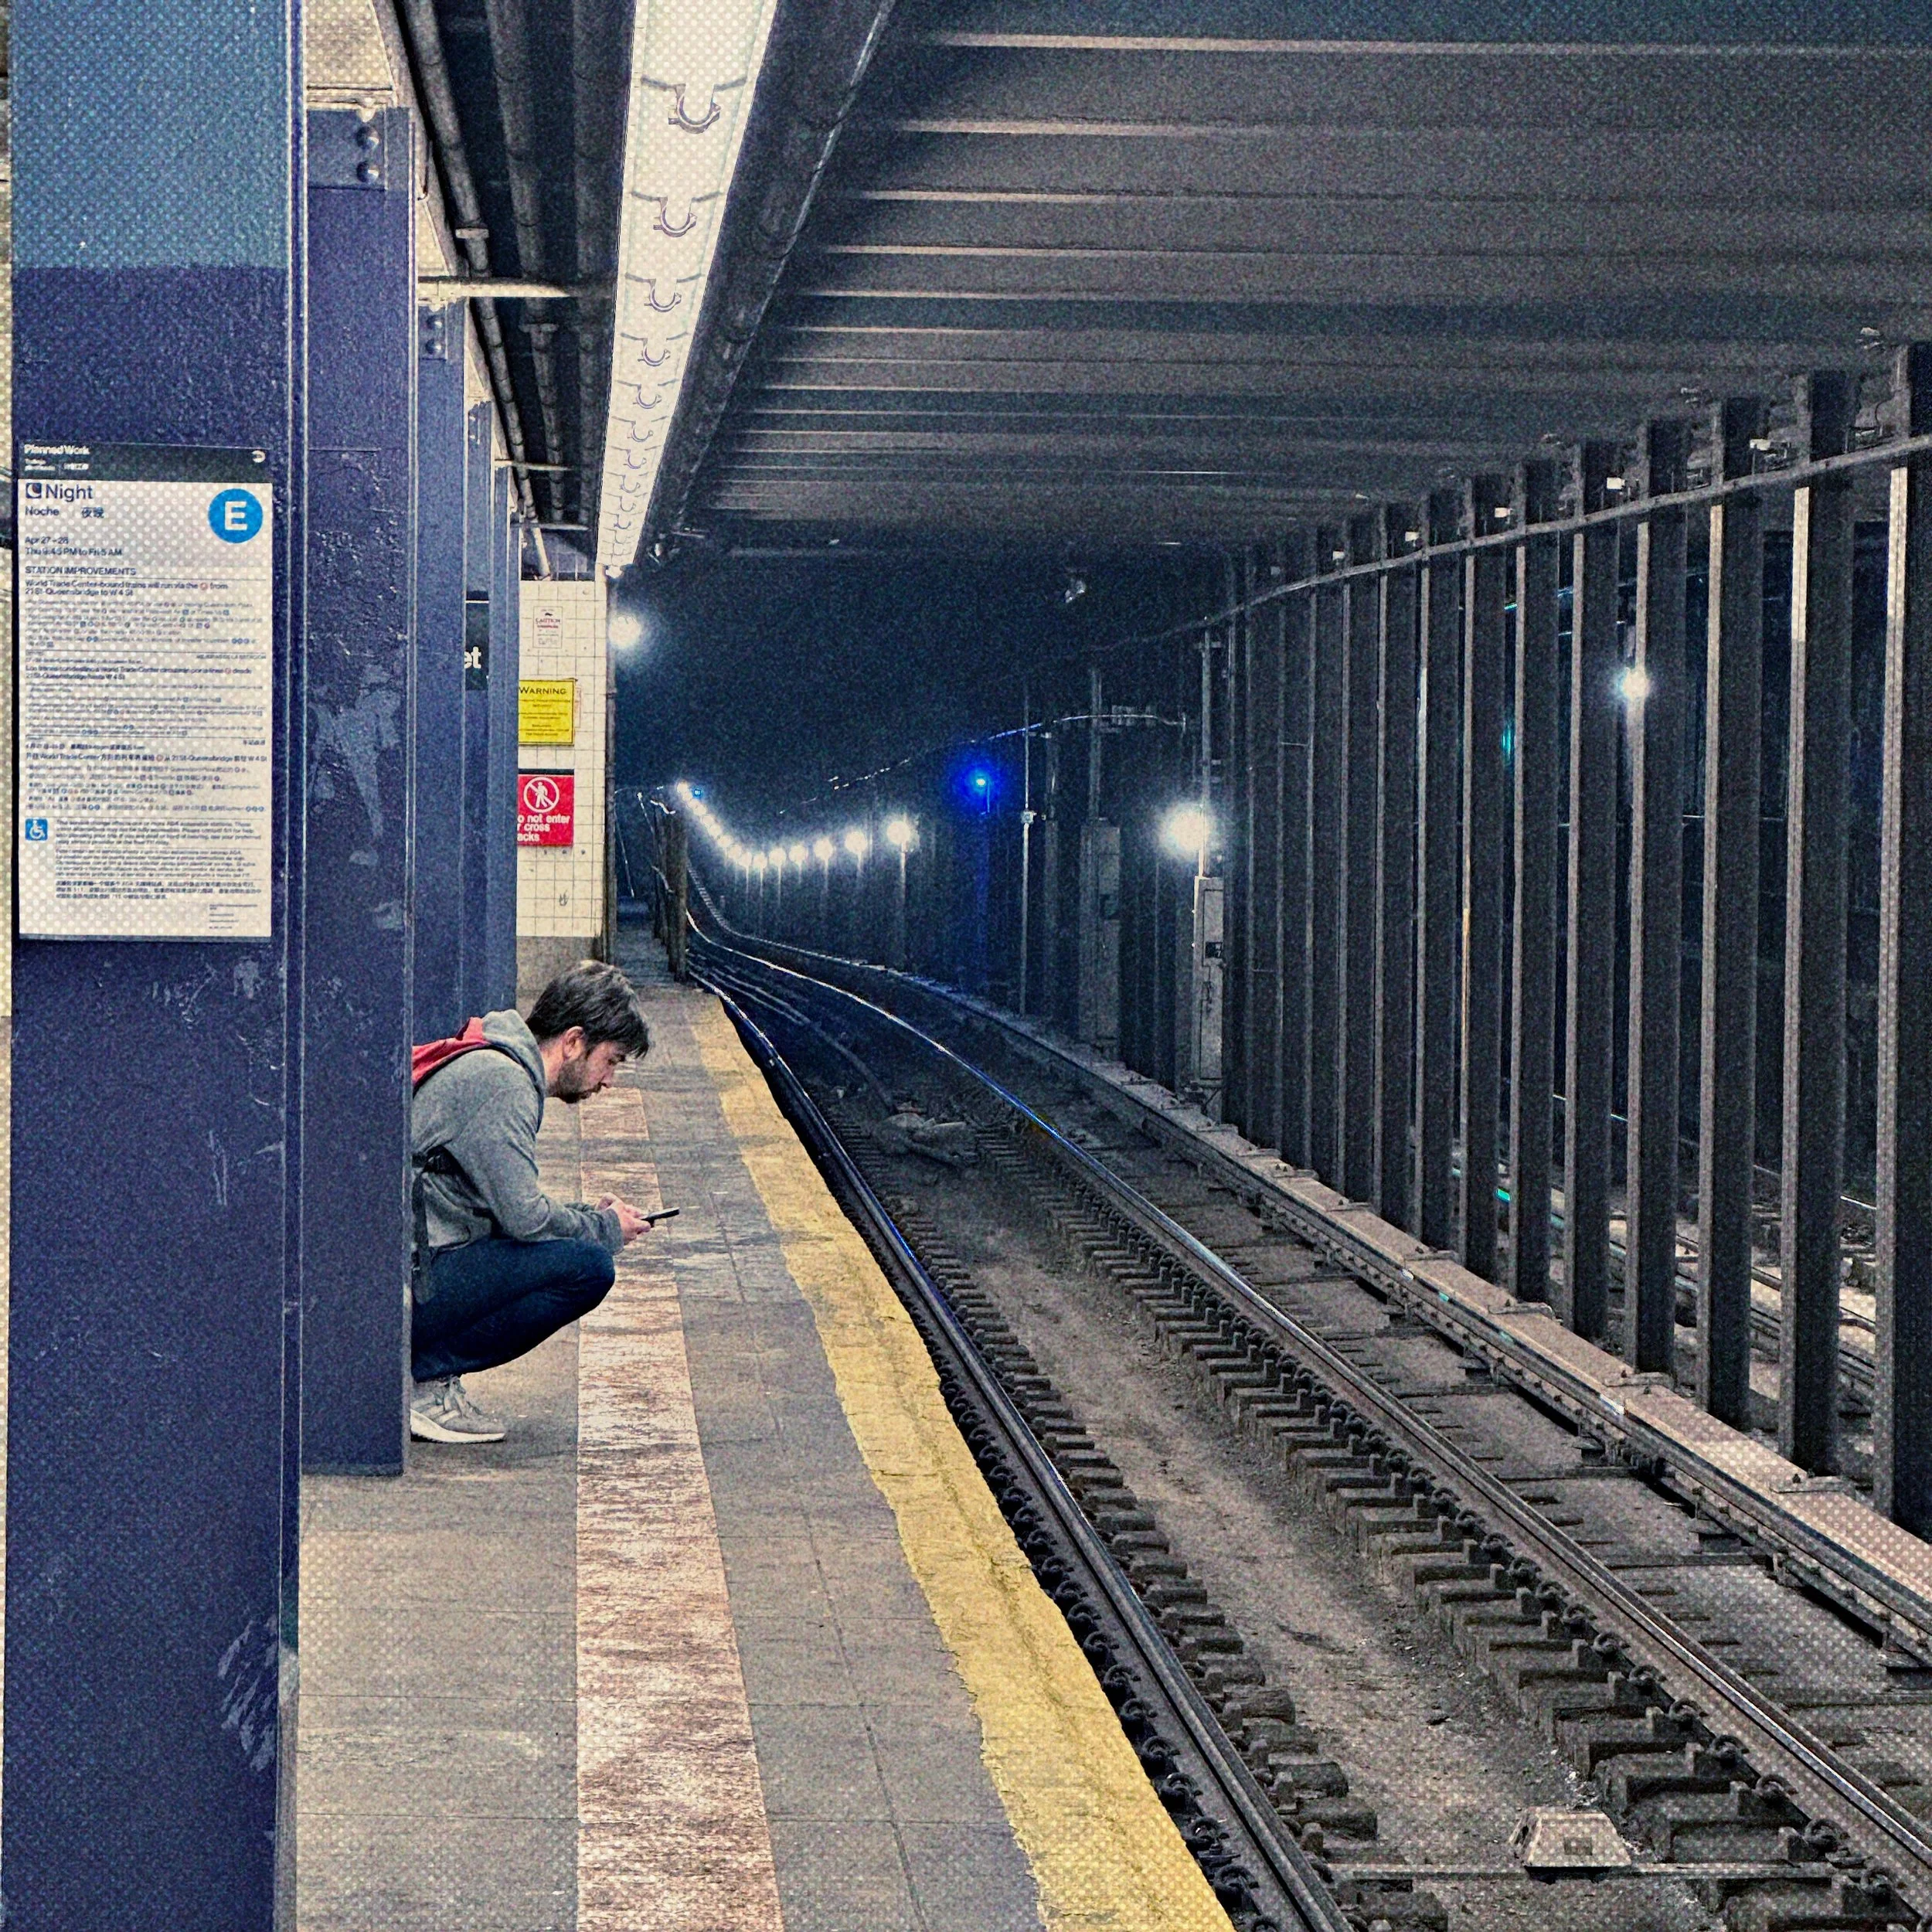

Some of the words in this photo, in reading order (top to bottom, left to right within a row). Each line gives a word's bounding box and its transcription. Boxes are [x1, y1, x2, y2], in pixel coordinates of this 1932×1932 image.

[25, 444, 63, 454] Planned
[63, 445, 90, 454] Work
[46, 483, 93, 502] Night
[25, 506, 60, 516] Noche
[224, 502, 248, 531] E
[25, 536, 38, 545] Apr
[517, 815, 526, 823] o
[527, 813, 543, 823] not
[546, 813, 570, 824] enter
[517, 832, 540, 842] acks
